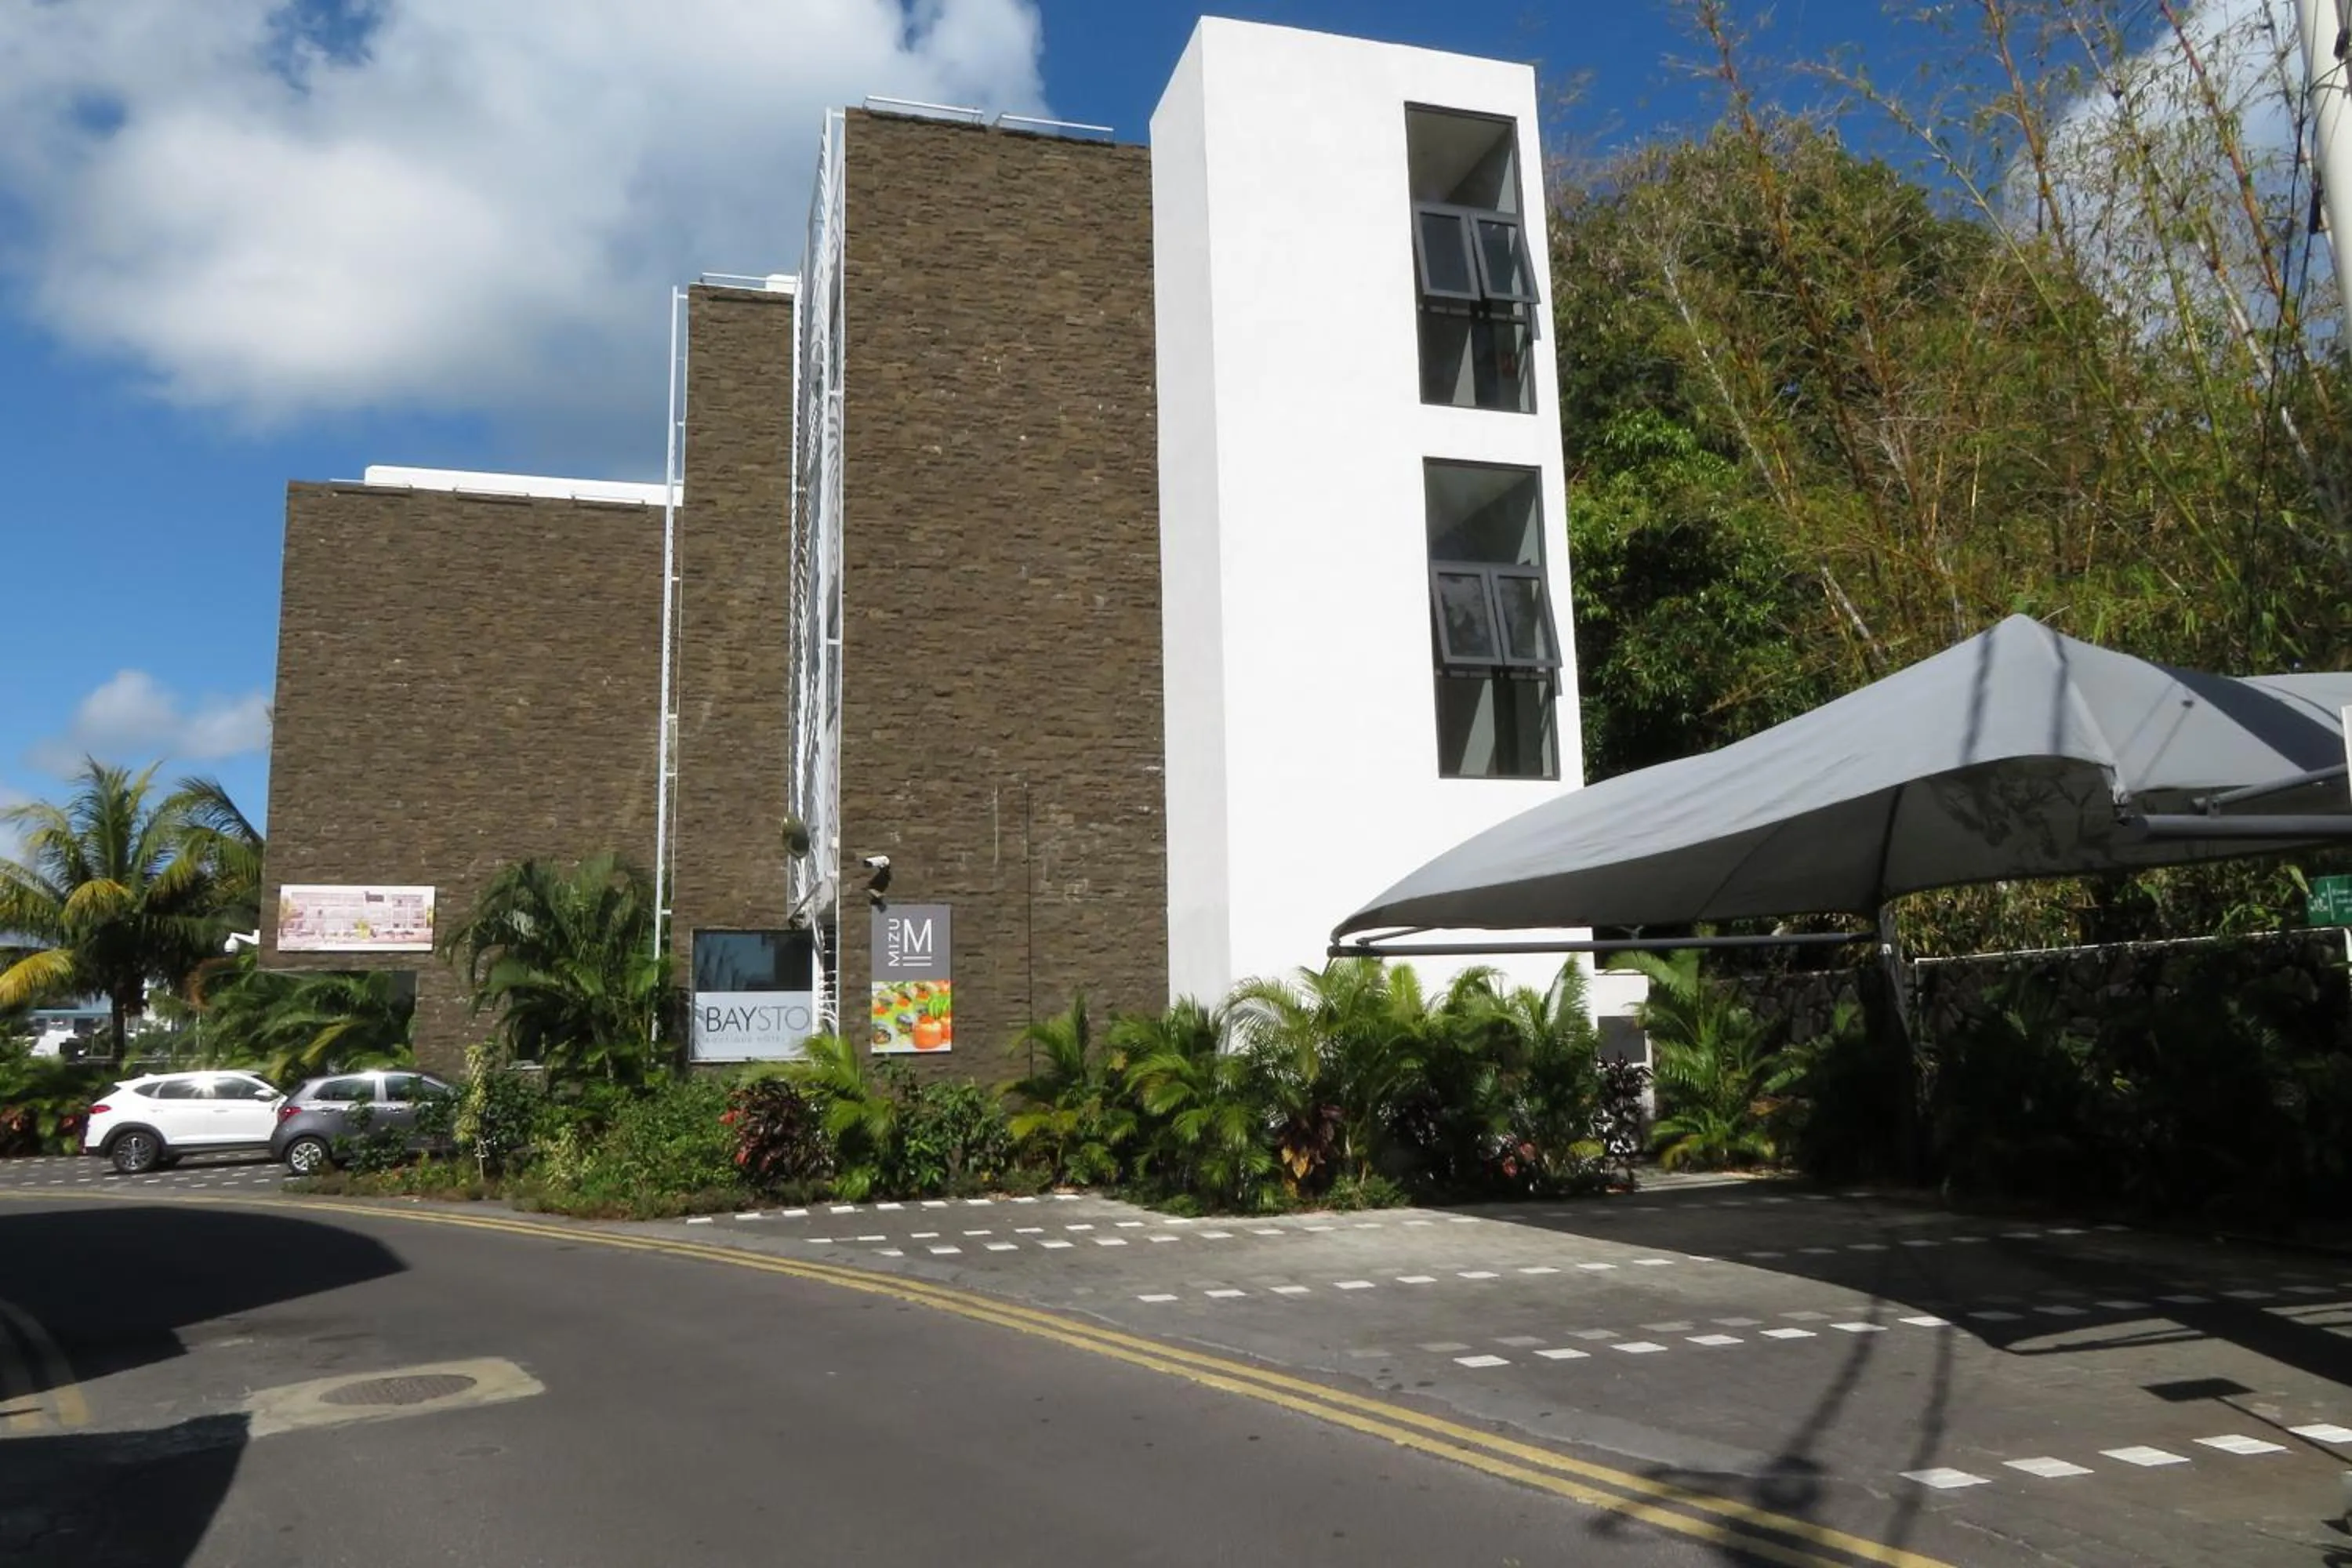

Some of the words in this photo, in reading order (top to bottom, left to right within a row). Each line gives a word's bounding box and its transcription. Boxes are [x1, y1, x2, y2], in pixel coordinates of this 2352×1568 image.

[888, 918, 900, 967] MIZU
[904, 918, 932, 953] M
[706, 1006, 810, 1032] BAYSTO
